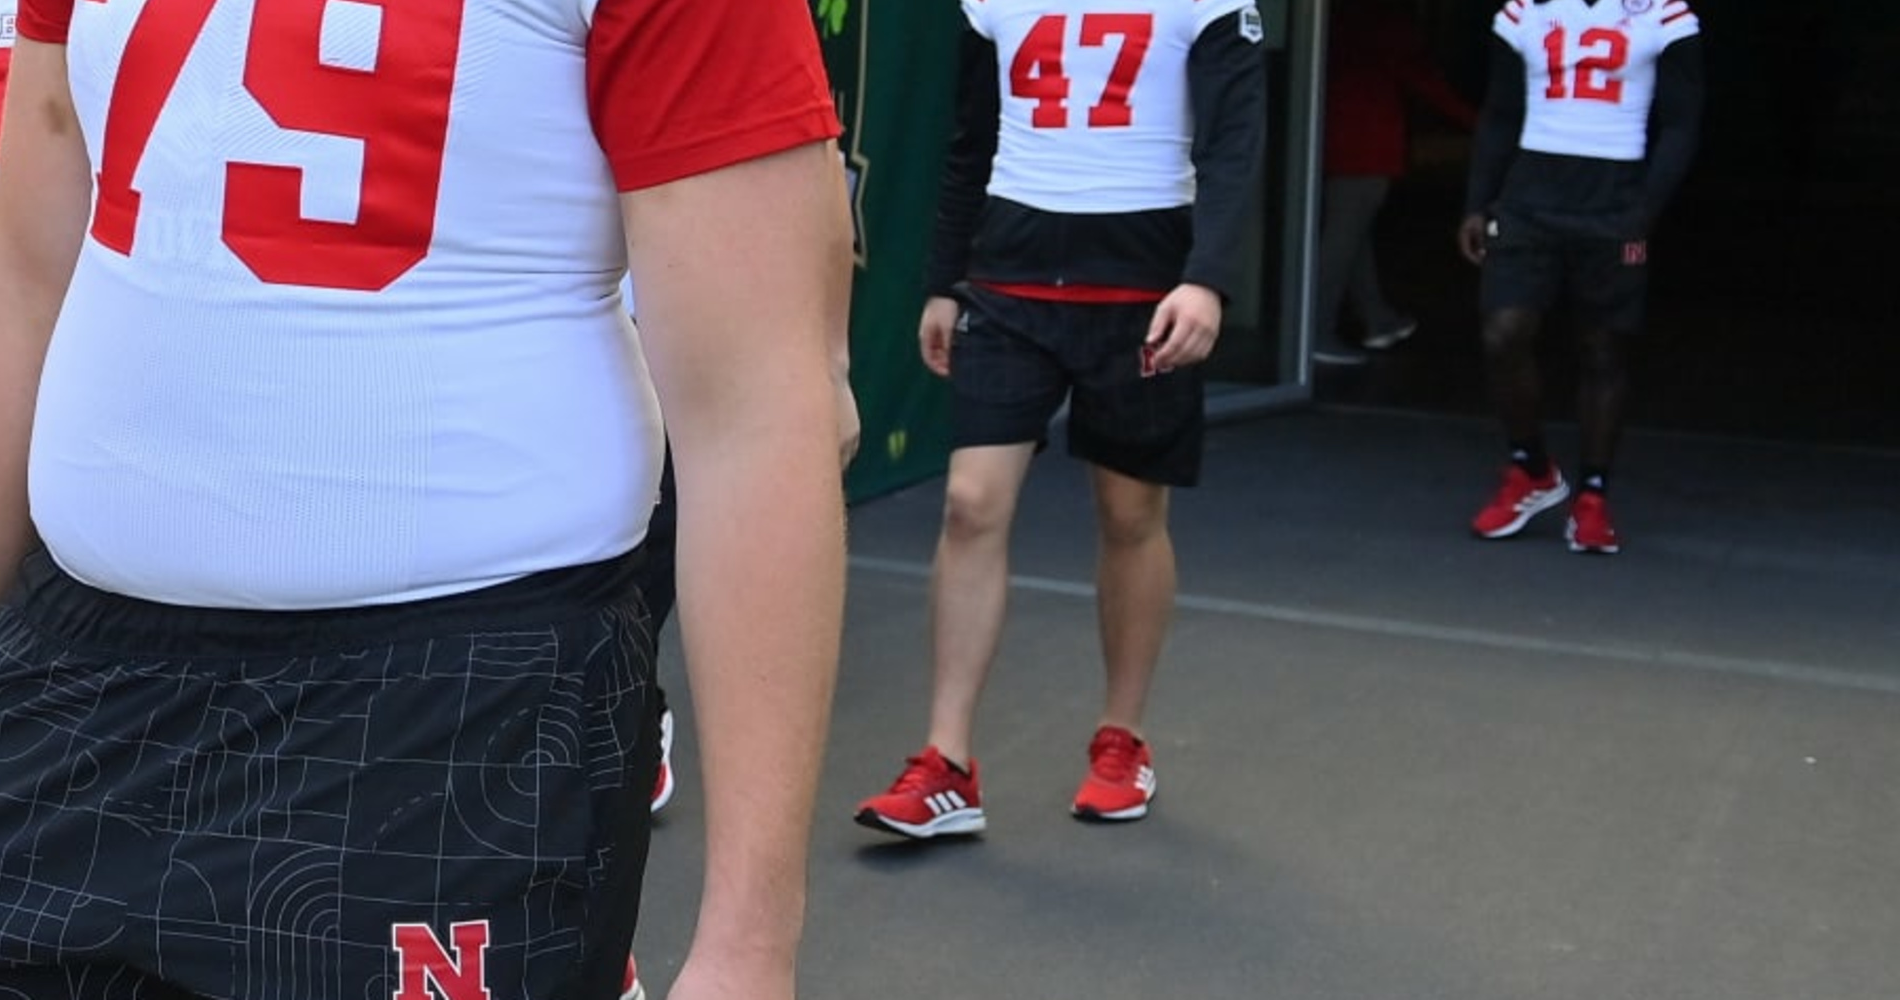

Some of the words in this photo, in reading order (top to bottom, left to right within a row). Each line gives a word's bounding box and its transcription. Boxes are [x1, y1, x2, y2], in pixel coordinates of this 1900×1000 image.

[1009, 13, 1154, 129] 47
[1544, 26, 1630, 105] 12
[392, 919, 491, 1000] N
